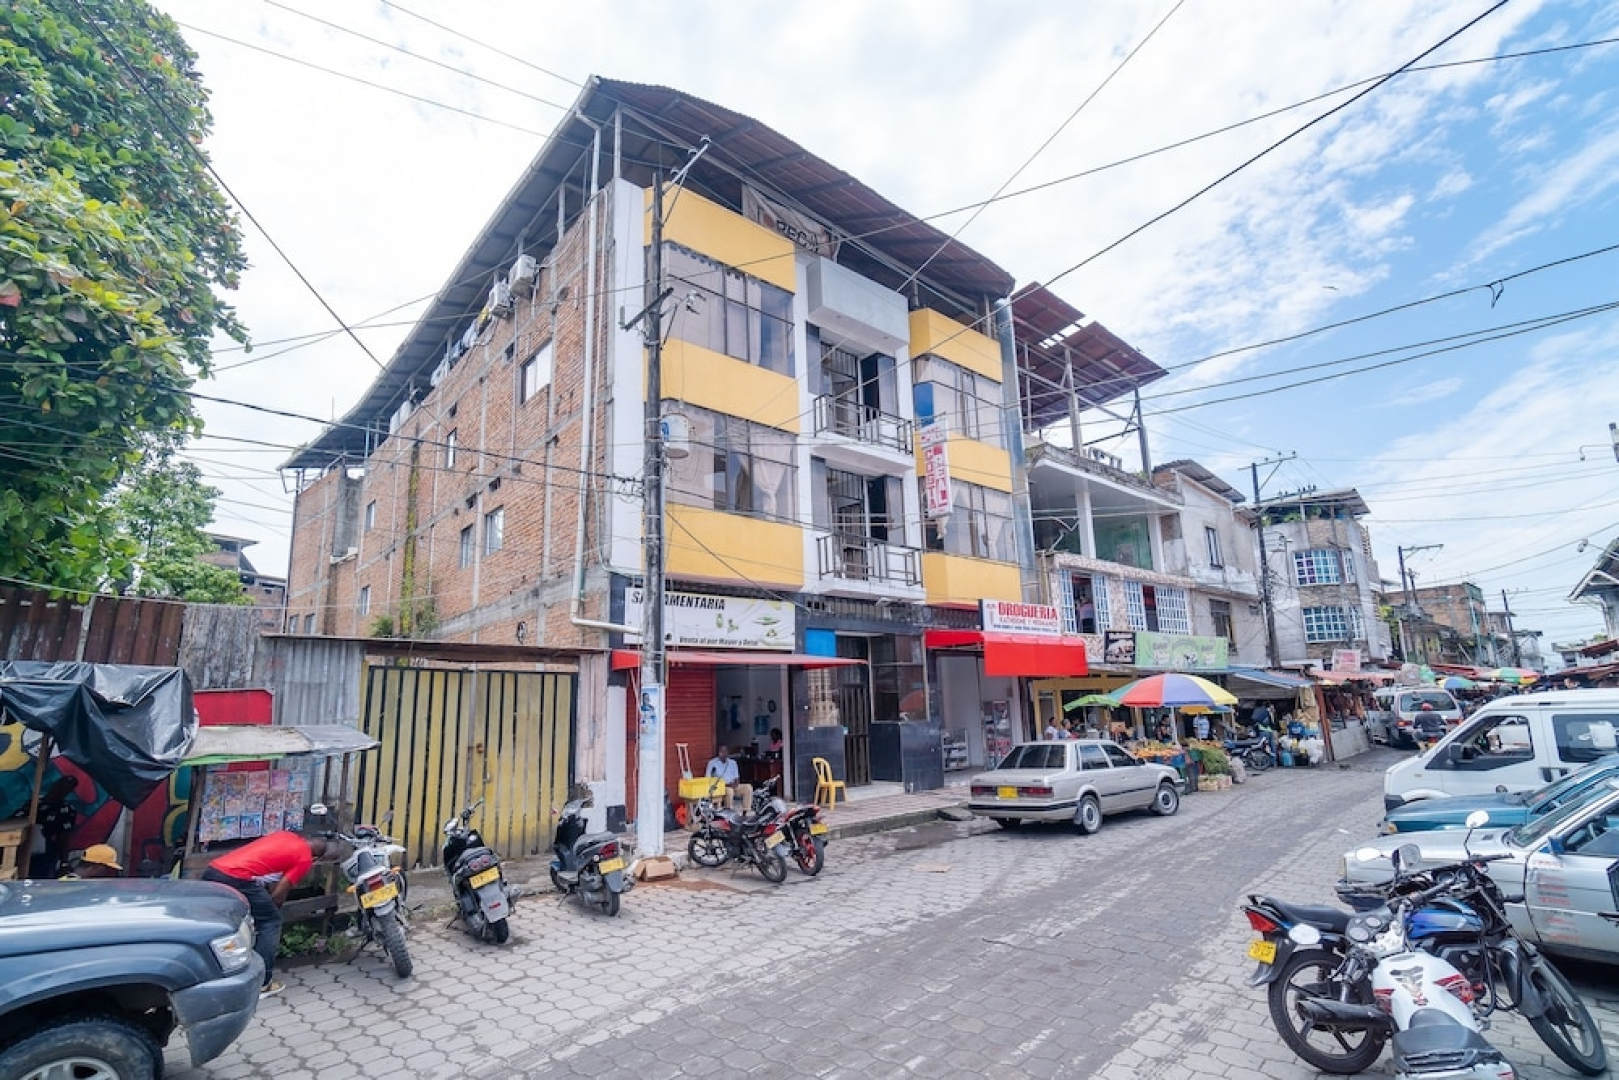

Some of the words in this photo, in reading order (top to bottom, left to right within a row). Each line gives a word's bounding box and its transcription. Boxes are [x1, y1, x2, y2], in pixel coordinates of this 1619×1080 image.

[631, 591, 725, 610] SAMENTARIA
[998, 602, 1058, 620] DROGUERIA
[679, 636, 698, 644] Venta
